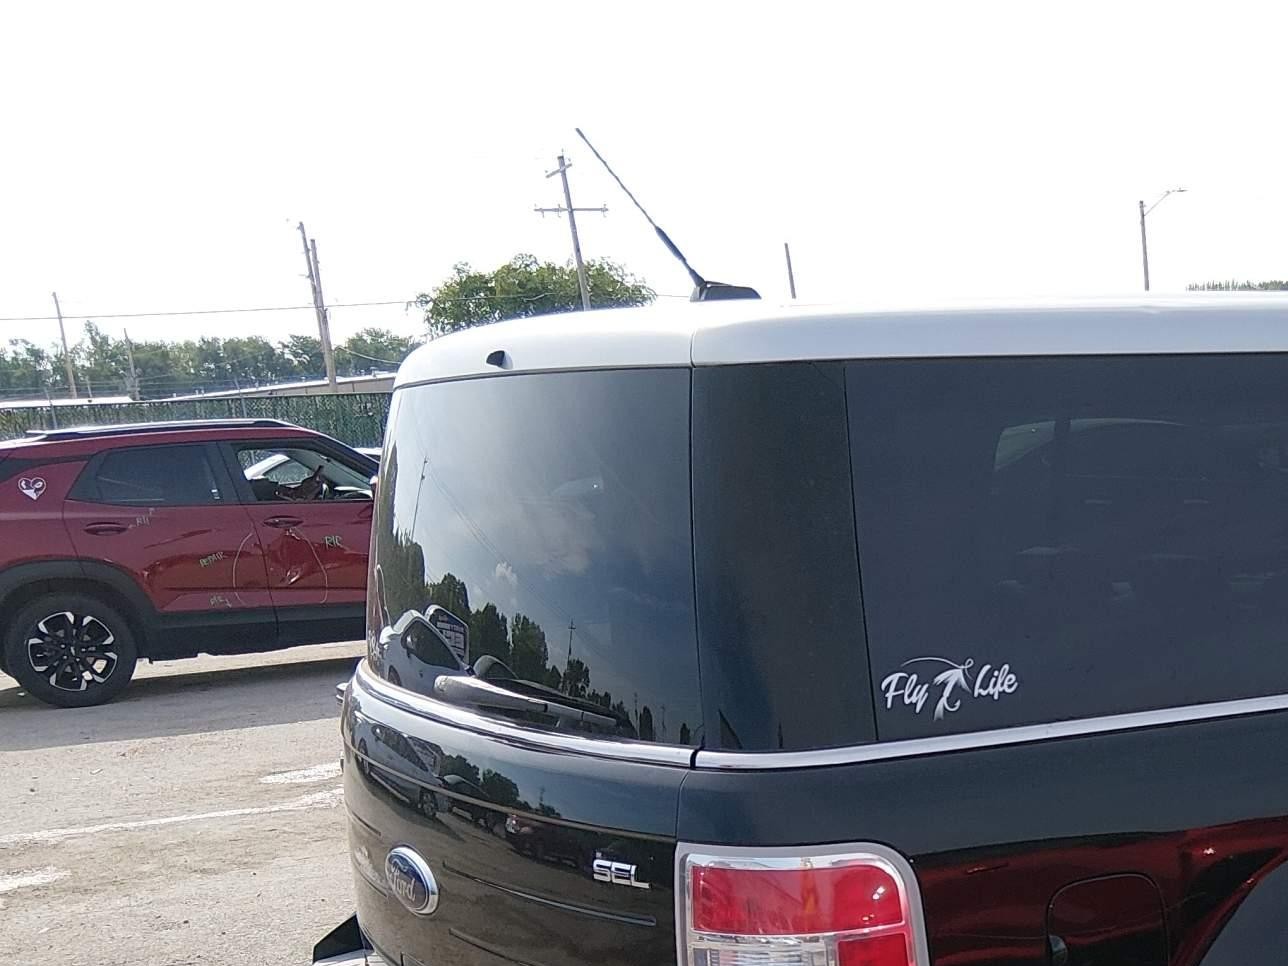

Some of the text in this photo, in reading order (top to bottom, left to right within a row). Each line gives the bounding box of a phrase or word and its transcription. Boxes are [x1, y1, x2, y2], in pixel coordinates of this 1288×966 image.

[881, 663, 1018, 714] Fly Life
[387, 857, 417, 902] Ford
[593, 859, 650, 889] SEL
